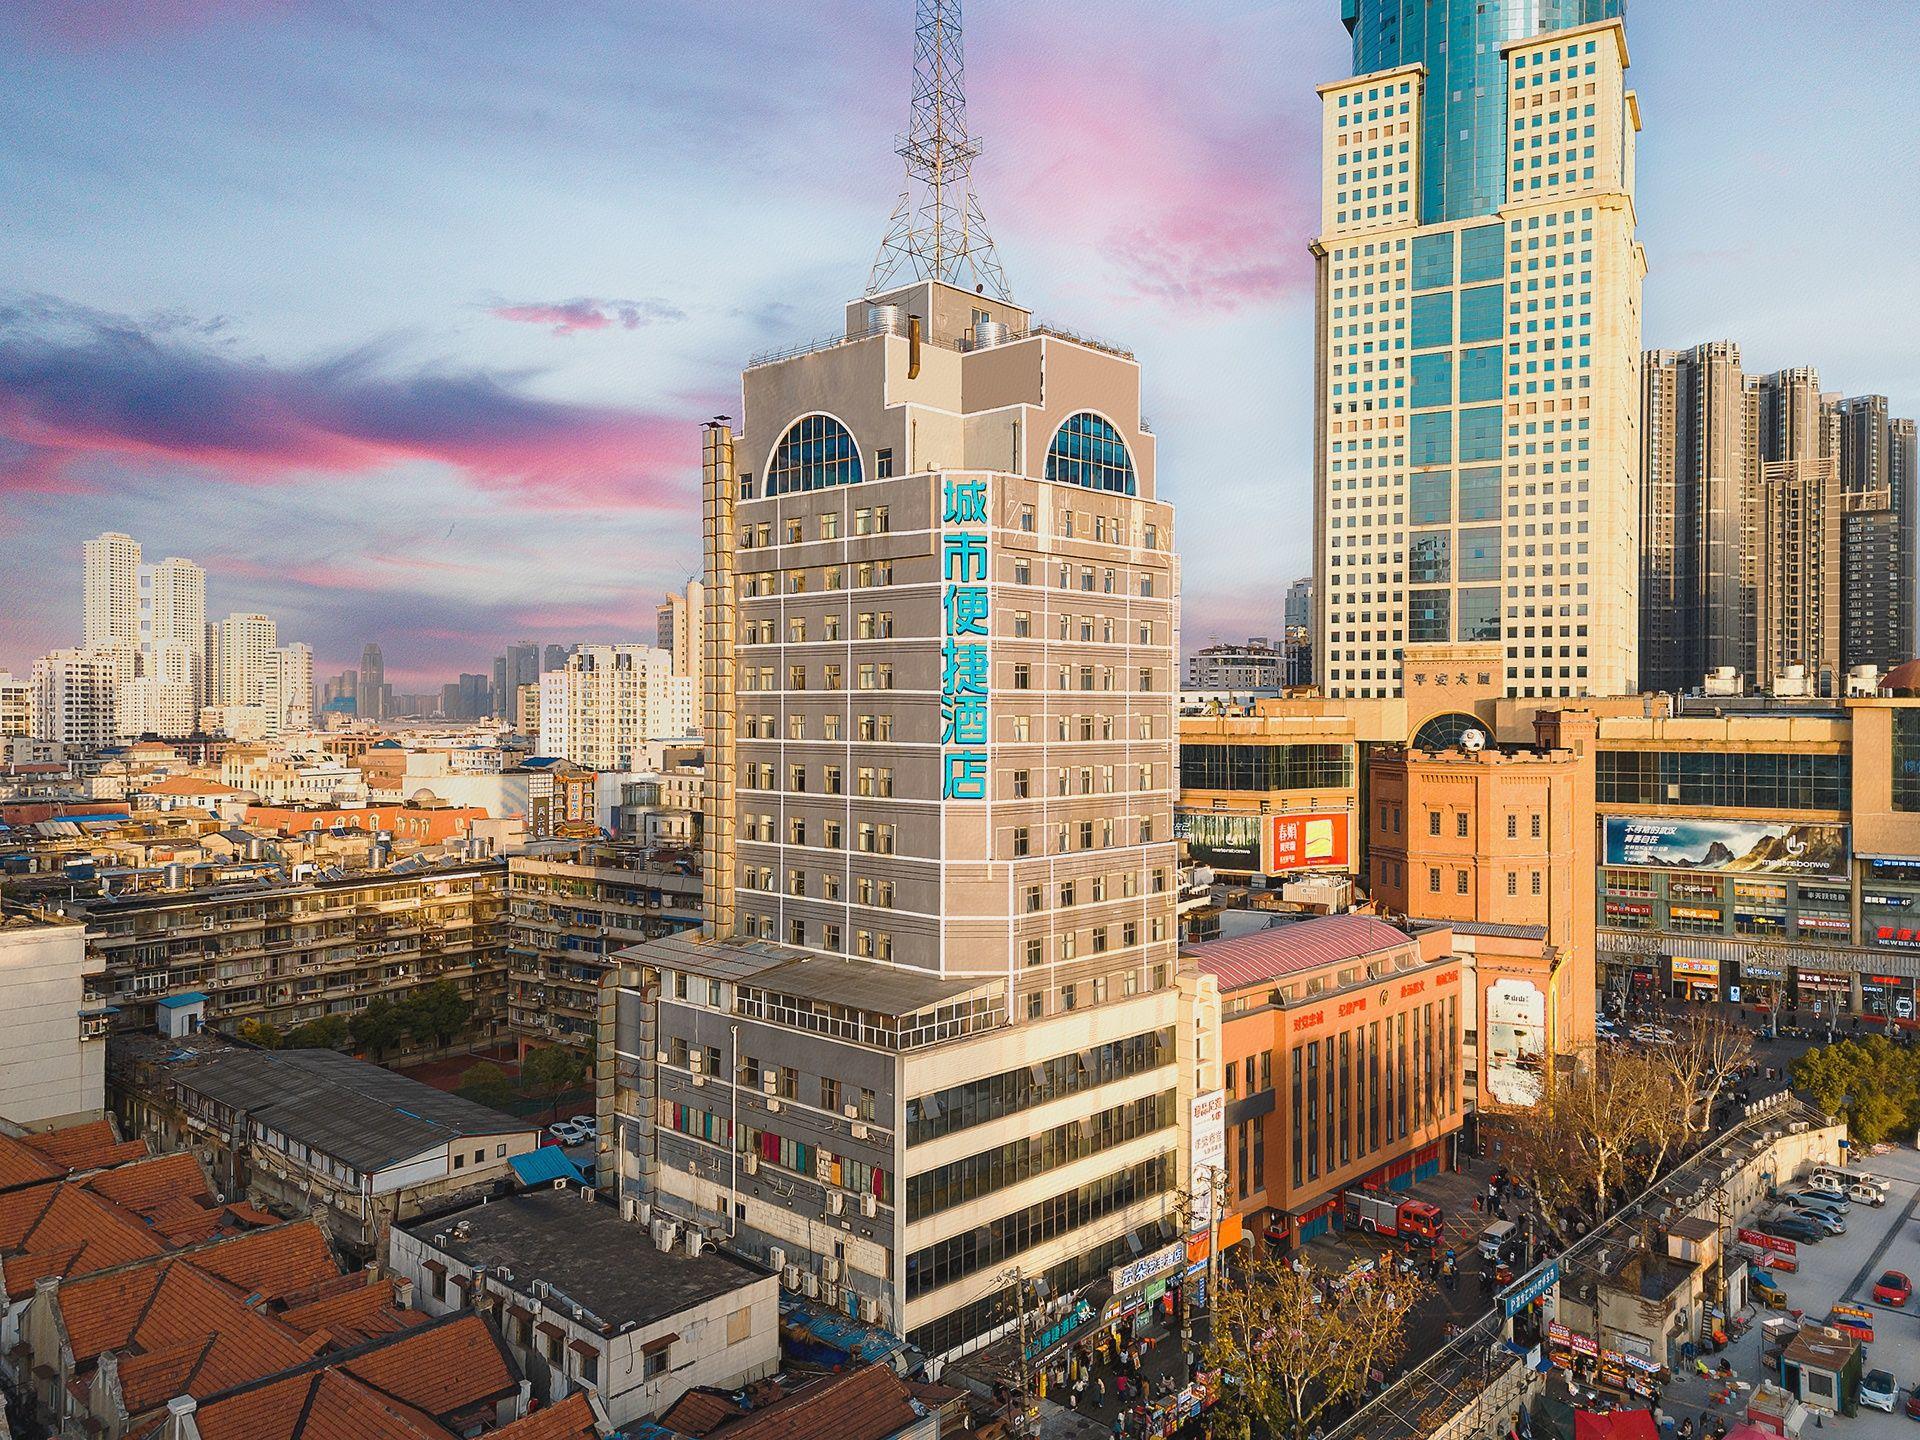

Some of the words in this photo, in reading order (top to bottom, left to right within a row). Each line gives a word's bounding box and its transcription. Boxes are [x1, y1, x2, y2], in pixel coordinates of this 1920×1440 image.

[942, 480, 989, 799] 城市便捷酒店
[1413, 672, 1491, 686] 平安大厦
[1293, 1009, 1324, 1032] 对党忠诚
